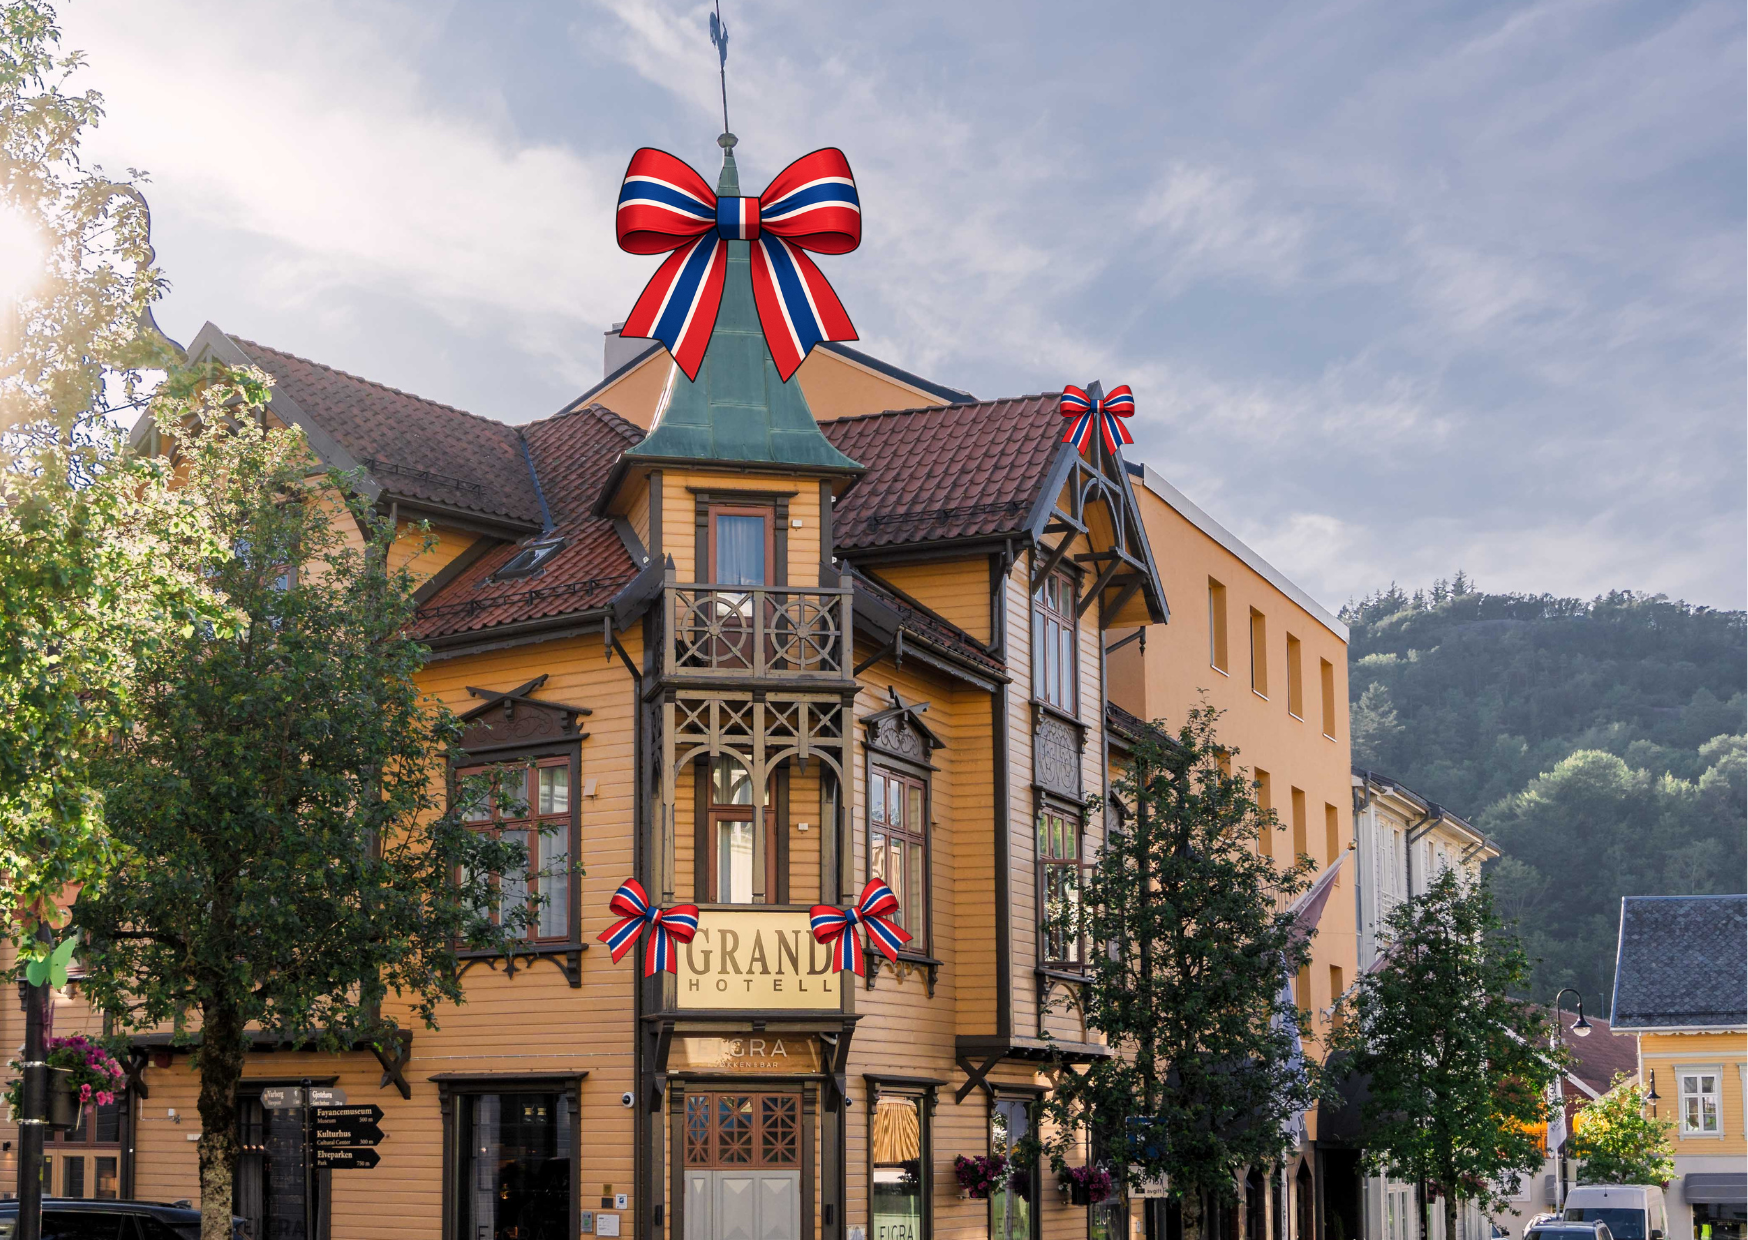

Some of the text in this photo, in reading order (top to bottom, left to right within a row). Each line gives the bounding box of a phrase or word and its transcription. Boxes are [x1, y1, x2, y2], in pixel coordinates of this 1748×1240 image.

[686, 928, 833, 976] GRAND
[689, 979, 832, 992] HOTELL
[317, 1108, 373, 1118] Fayancemuseum
[316, 1130, 352, 1139] Kulturhus
[317, 1150, 353, 1160] Elveparken
